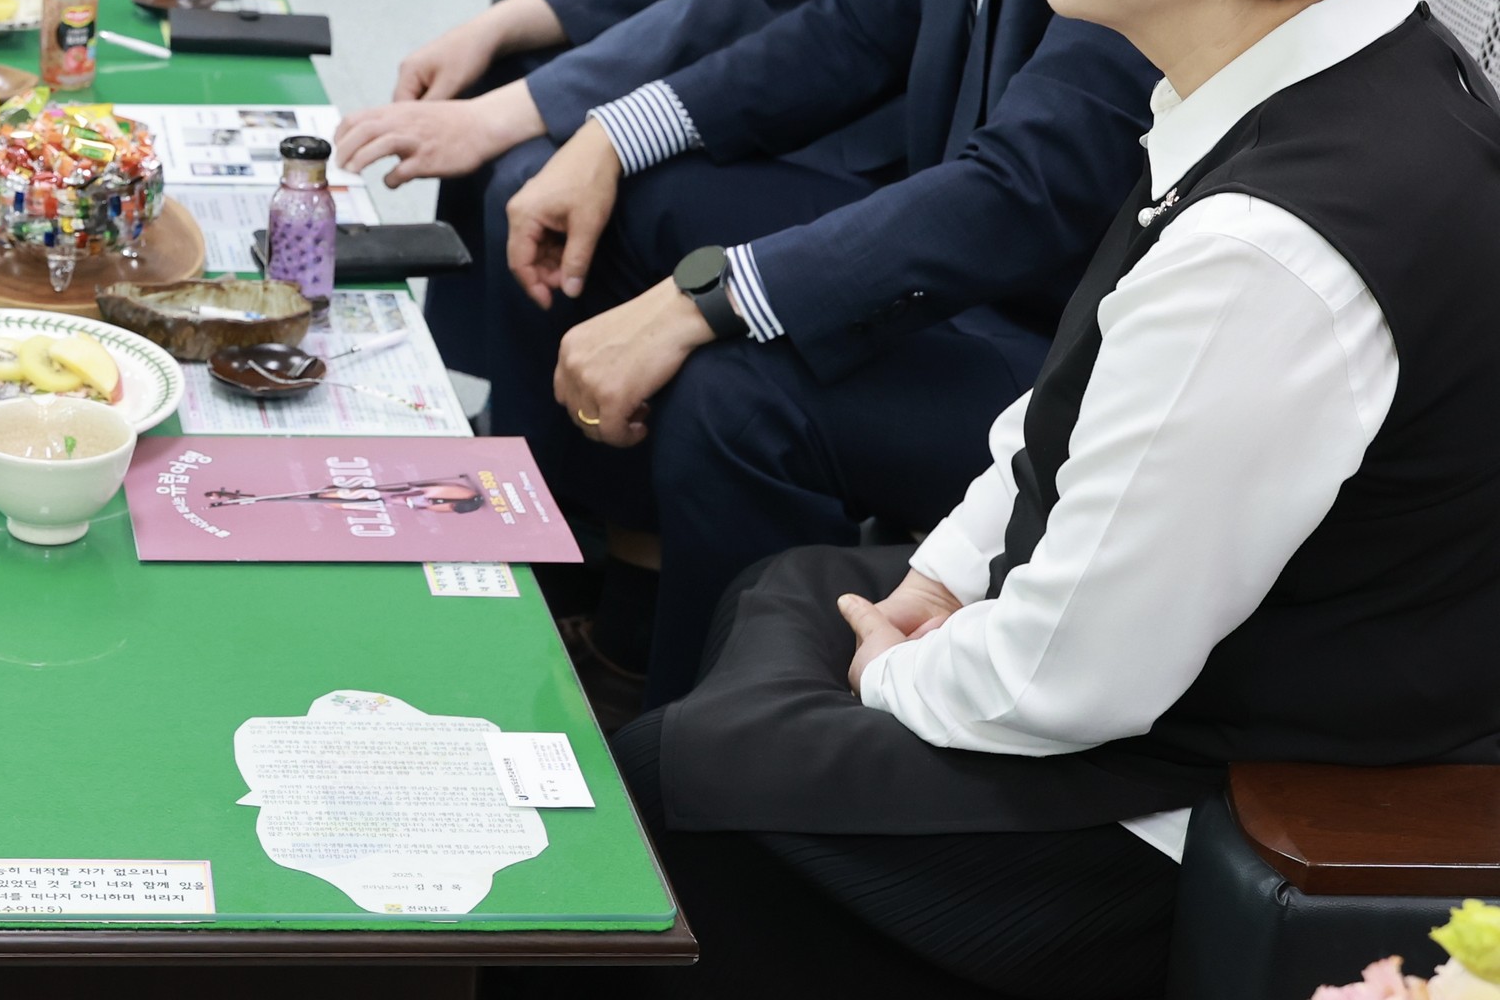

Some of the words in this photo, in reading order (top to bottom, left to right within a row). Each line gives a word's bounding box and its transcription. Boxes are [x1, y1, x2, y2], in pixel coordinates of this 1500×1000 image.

[156, 449, 213, 497] 유럽여행
[325, 456, 396, 538] CLASSIC
[29, 866, 70, 876] 대적할
[78, 867, 105, 876] 자가
[113, 867, 168, 877] 없으리니
[47, 880, 60, 889] 것
[70, 880, 96, 889] 같이
[107, 880, 133, 889] 너와
[143, 881, 170, 890] 함께
[179, 881, 206, 891] 있을
[31, 893, 72, 901] 떠나지
[80, 893, 135, 902] 아니하며
[144, 893, 185, 903] 버리지
[407, 905, 451, 913] 전라남도
